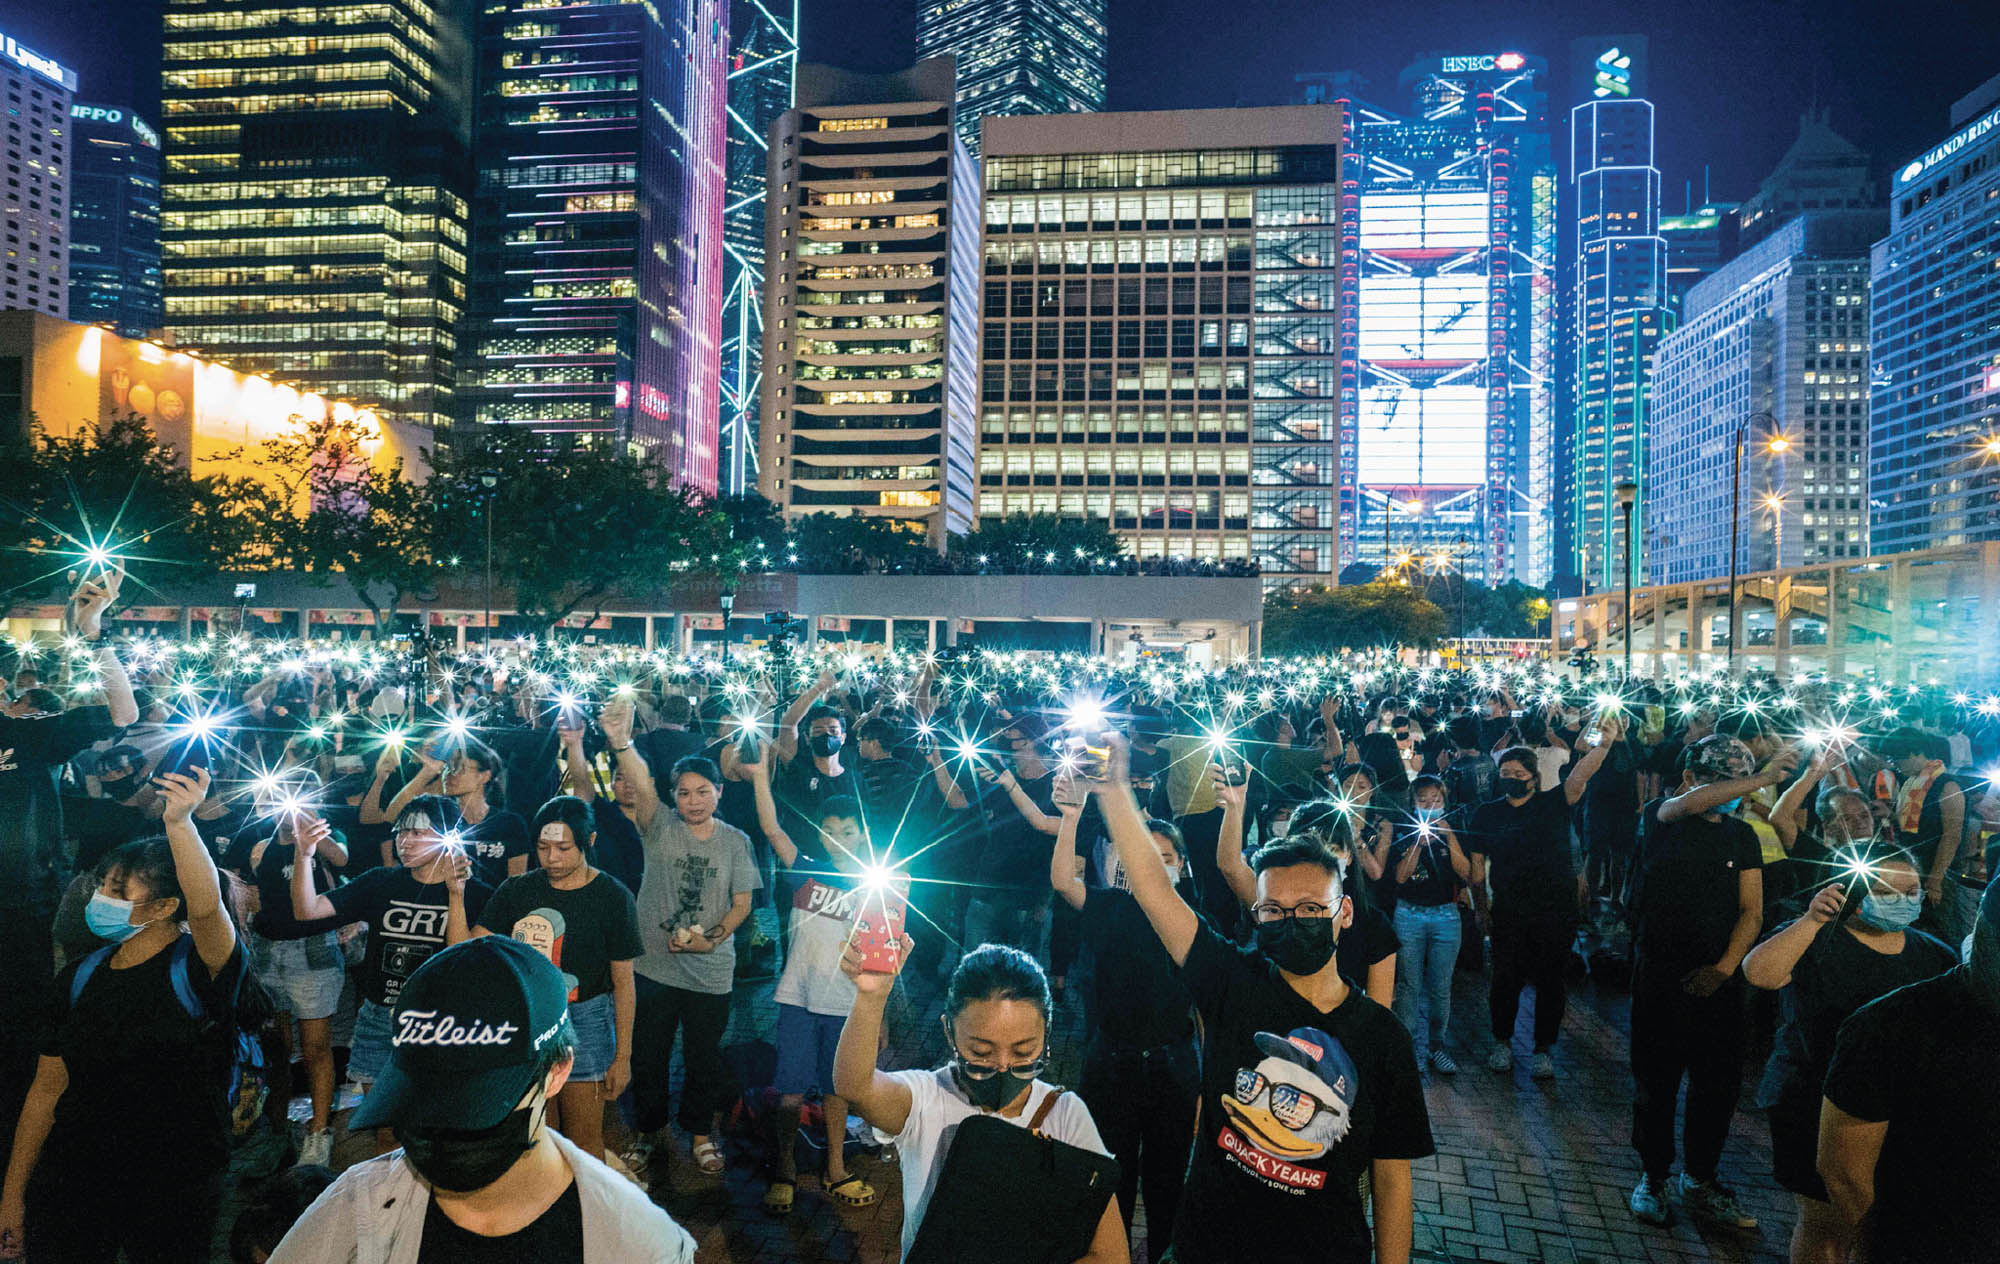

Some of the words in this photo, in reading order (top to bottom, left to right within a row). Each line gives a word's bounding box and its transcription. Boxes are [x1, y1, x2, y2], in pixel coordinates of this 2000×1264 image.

[6, 36, 63, 82] Lynch
[1442, 55, 1495, 72] HSBC
[70, 104, 122, 123] IPPO
[807, 885, 853, 919] PUM
[392, 1010, 519, 1047] Titleist
[534, 1023, 559, 1051] PRO
[1224, 1133, 1269, 1172] QUACK
[1271, 1159, 1321, 1187] YEAHS
